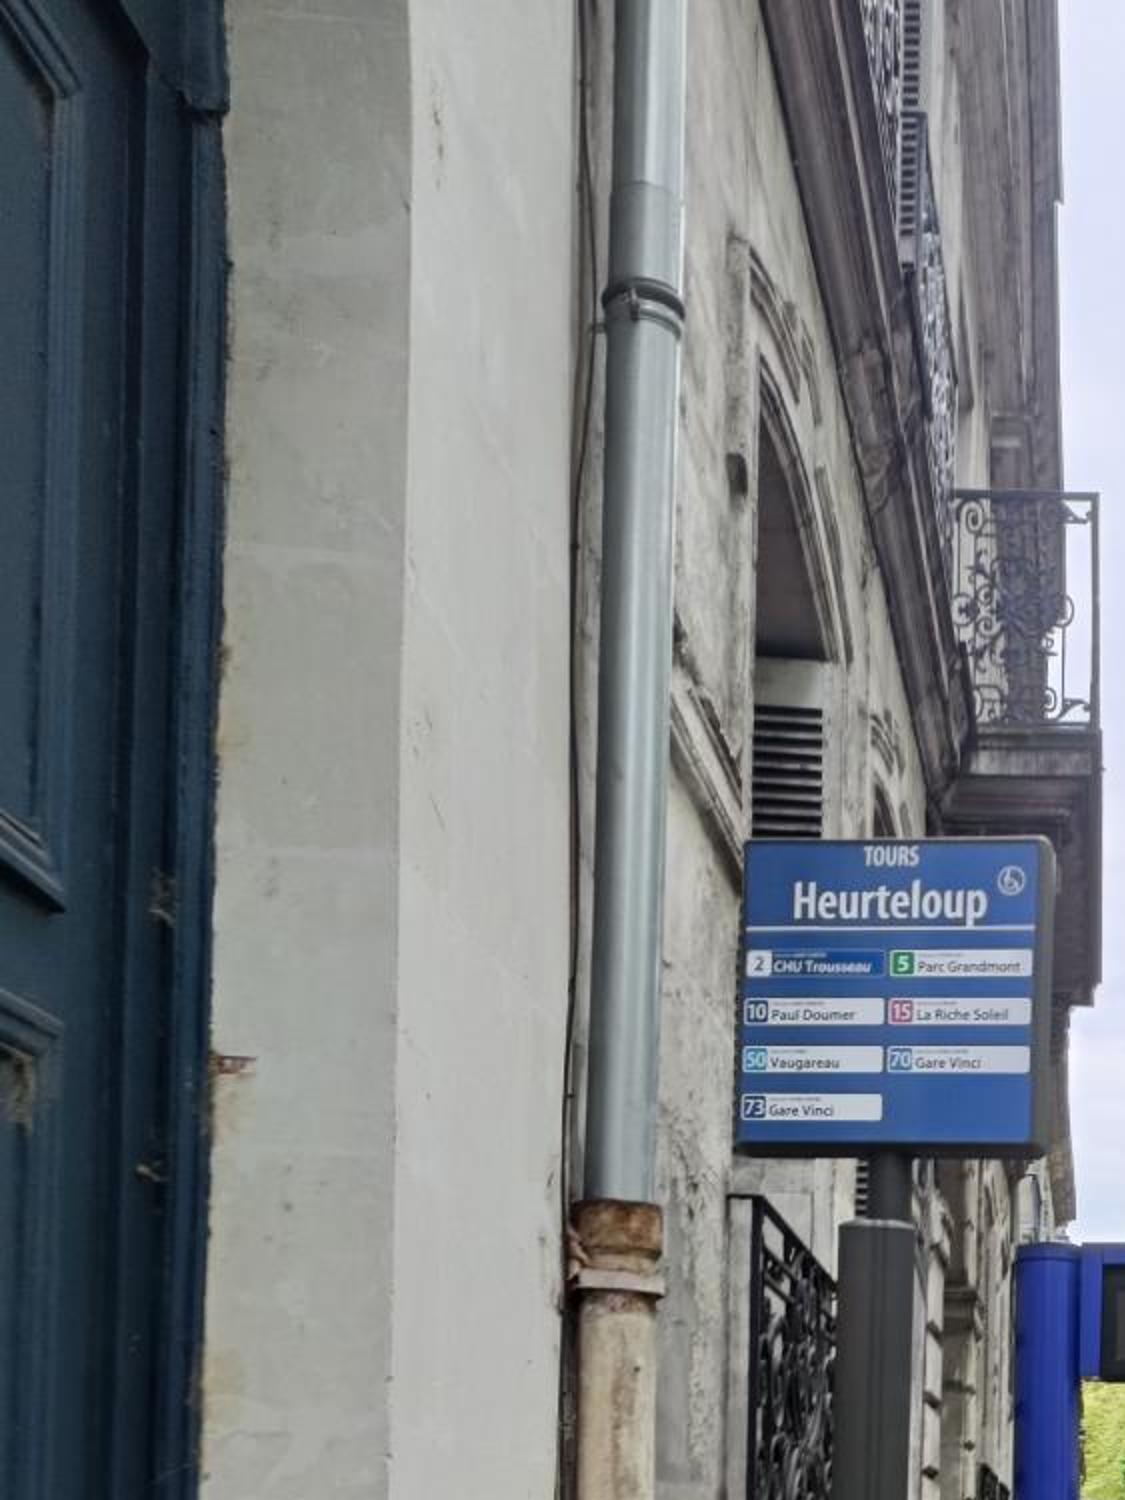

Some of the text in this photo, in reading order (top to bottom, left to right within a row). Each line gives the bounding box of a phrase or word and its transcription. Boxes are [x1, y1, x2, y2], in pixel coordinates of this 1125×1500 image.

[864, 845, 919, 867] TOURS
[793, 880, 987, 927] Heurteloup
[753, 956, 765, 972] 2
[773, 959, 803, 973] CHU
[897, 955, 910, 973] 5
[918, 961, 944, 973] Parc
[947, 960, 1021, 973] Grandmont
[747, 1003, 767, 1020] 10
[771, 1009, 799, 1020] Paul
[803, 1009, 855, 1021] Doumer
[892, 1003, 912, 1020] 15
[916, 1009, 931, 1021] La
[935, 1008, 970, 1021] Riche
[973, 1008, 1008, 1021] Soleil
[745, 1050, 840, 1070] 50 Vaugareau
[890, 1050, 911, 1068] 70
[914, 1056, 946, 1069] Gare
[948, 1056, 981, 1069] Vinci
[744, 1099, 765, 1117] 73
[769, 1104, 799, 1117] Gare
[801, 1103, 834, 1117] Vinci
